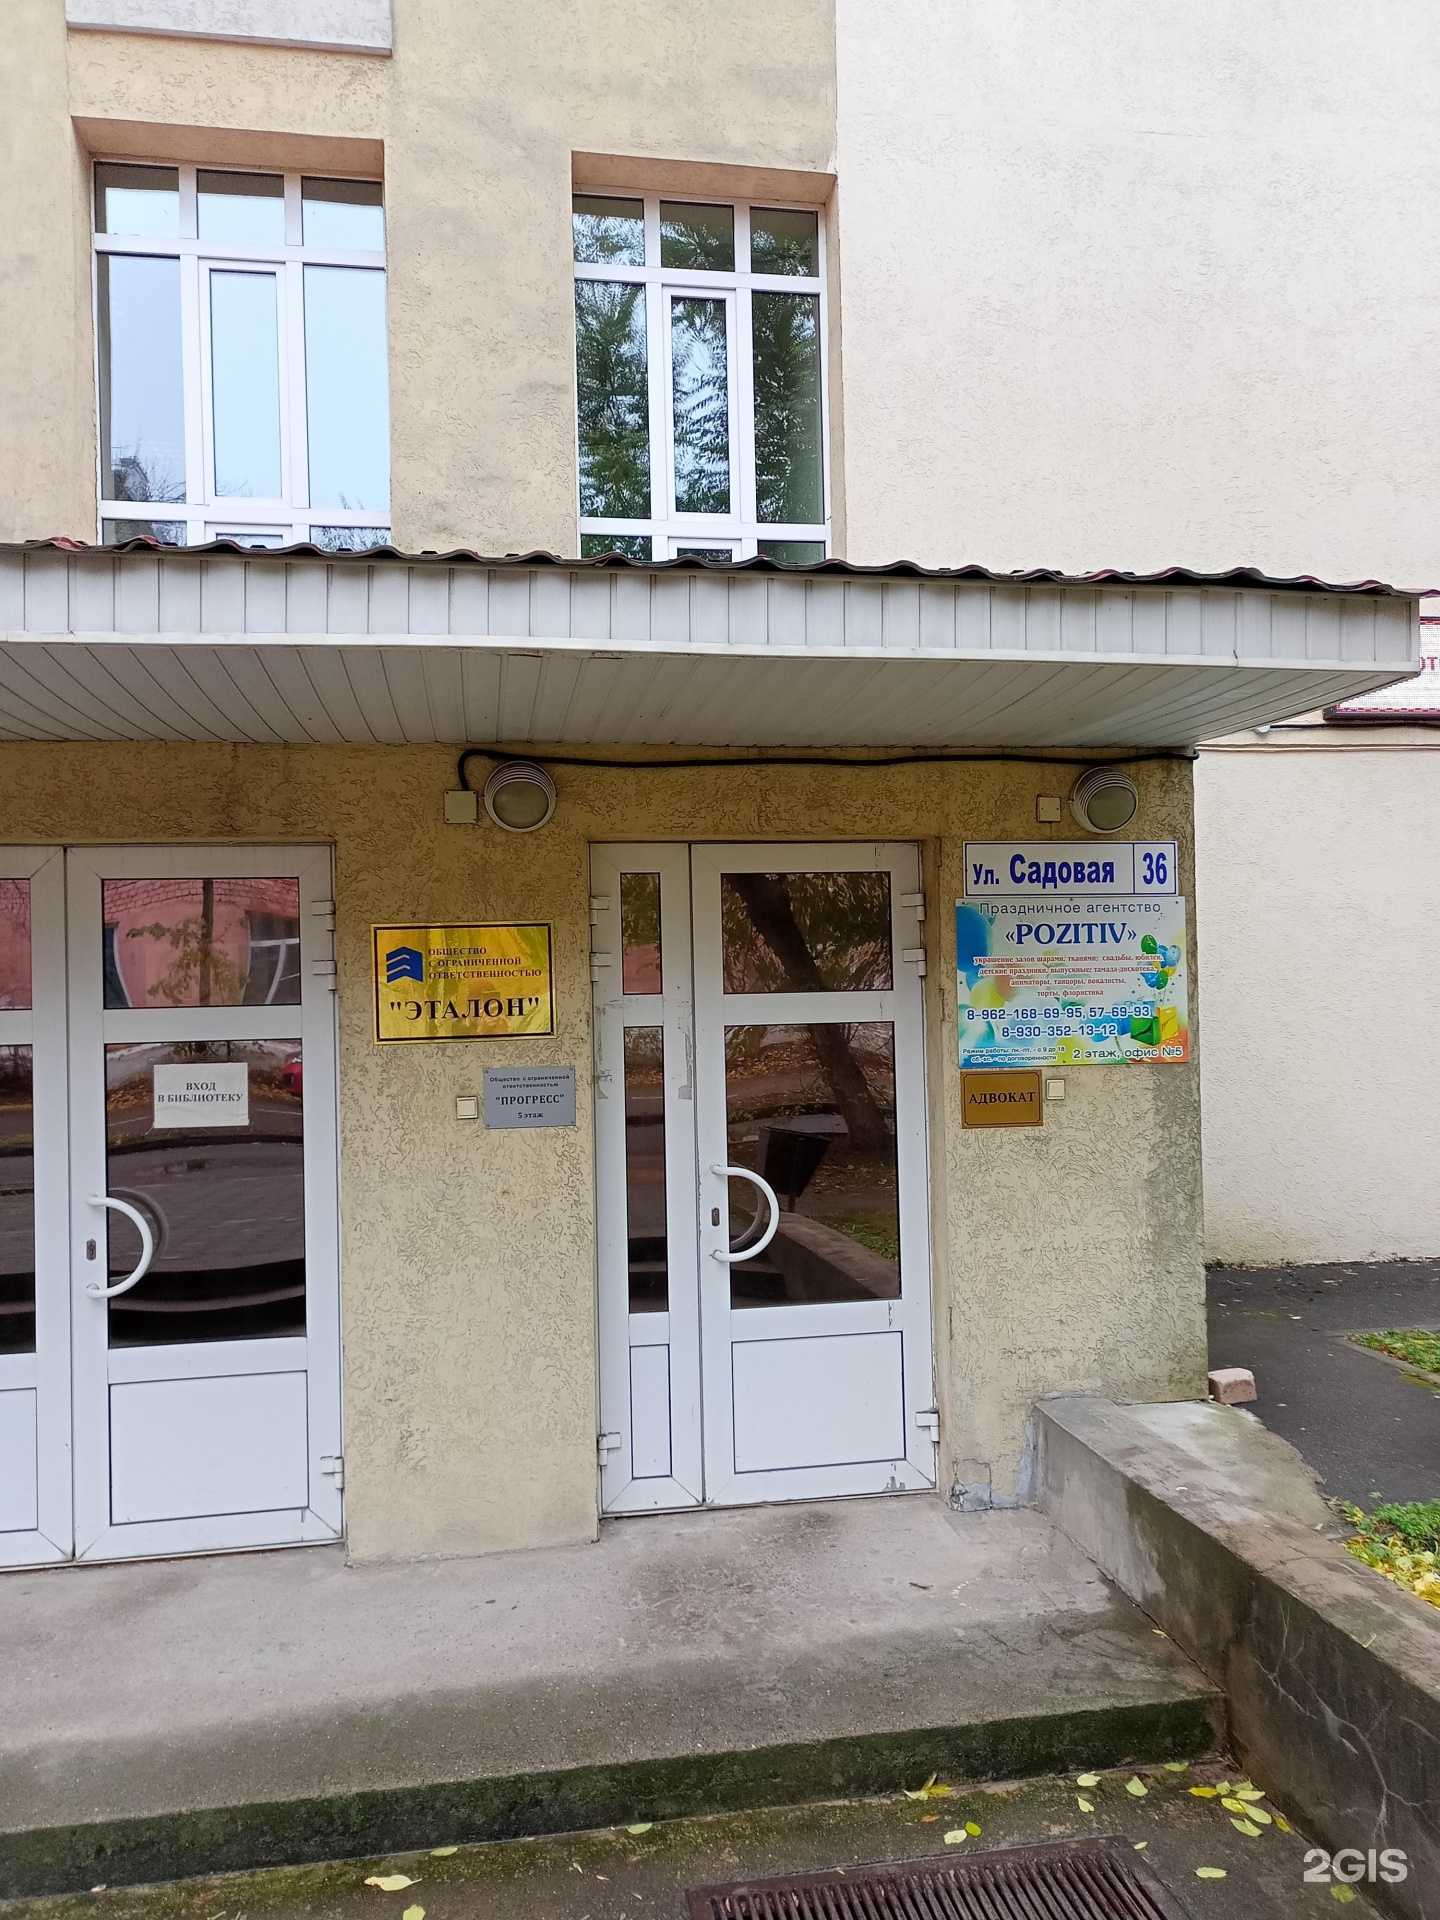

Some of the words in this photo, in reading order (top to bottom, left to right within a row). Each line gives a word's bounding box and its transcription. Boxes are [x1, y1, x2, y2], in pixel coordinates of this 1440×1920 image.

[972, 863, 1000, 885] Ул.
[1009, 853, 1115, 889] Садовая
[1142, 852, 1168, 885] 36
[979, 902, 1081, 916] Праздничное
[1086, 902, 1161, 914] агентство
[1005, 922, 1137, 945] «POZITIV»
[428, 947, 487, 956] ОБЩЕСТВО
[437, 958, 521, 967] ОГРАНИЧЕННОЙ
[429, 969, 542, 980] ОТВЕТСТВЕННОСТЬЮ
[390, 996, 540, 1020] "ЭТАЛОН"
[966, 1006, 1086, 1020] 8-962-168-69-95,
[1089, 1006, 1150, 1018] 57-69-93
[1002, 1025, 1117, 1038] 8-930-352-13-12
[1073, 1049, 1081, 1059] 2
[1124, 1048, 1159, 1058] офис
[1162, 1046, 1184, 1057] №5
[185, 1081, 217, 1091] ВХОД
[157, 1094, 165, 1102] В
[167, 1093, 243, 1103] БИБЛИОТЕКУ
[495, 1094, 565, 1106] "ПРОГРЕСС"
[969, 1091, 1037, 1104] АДВОКАТ
